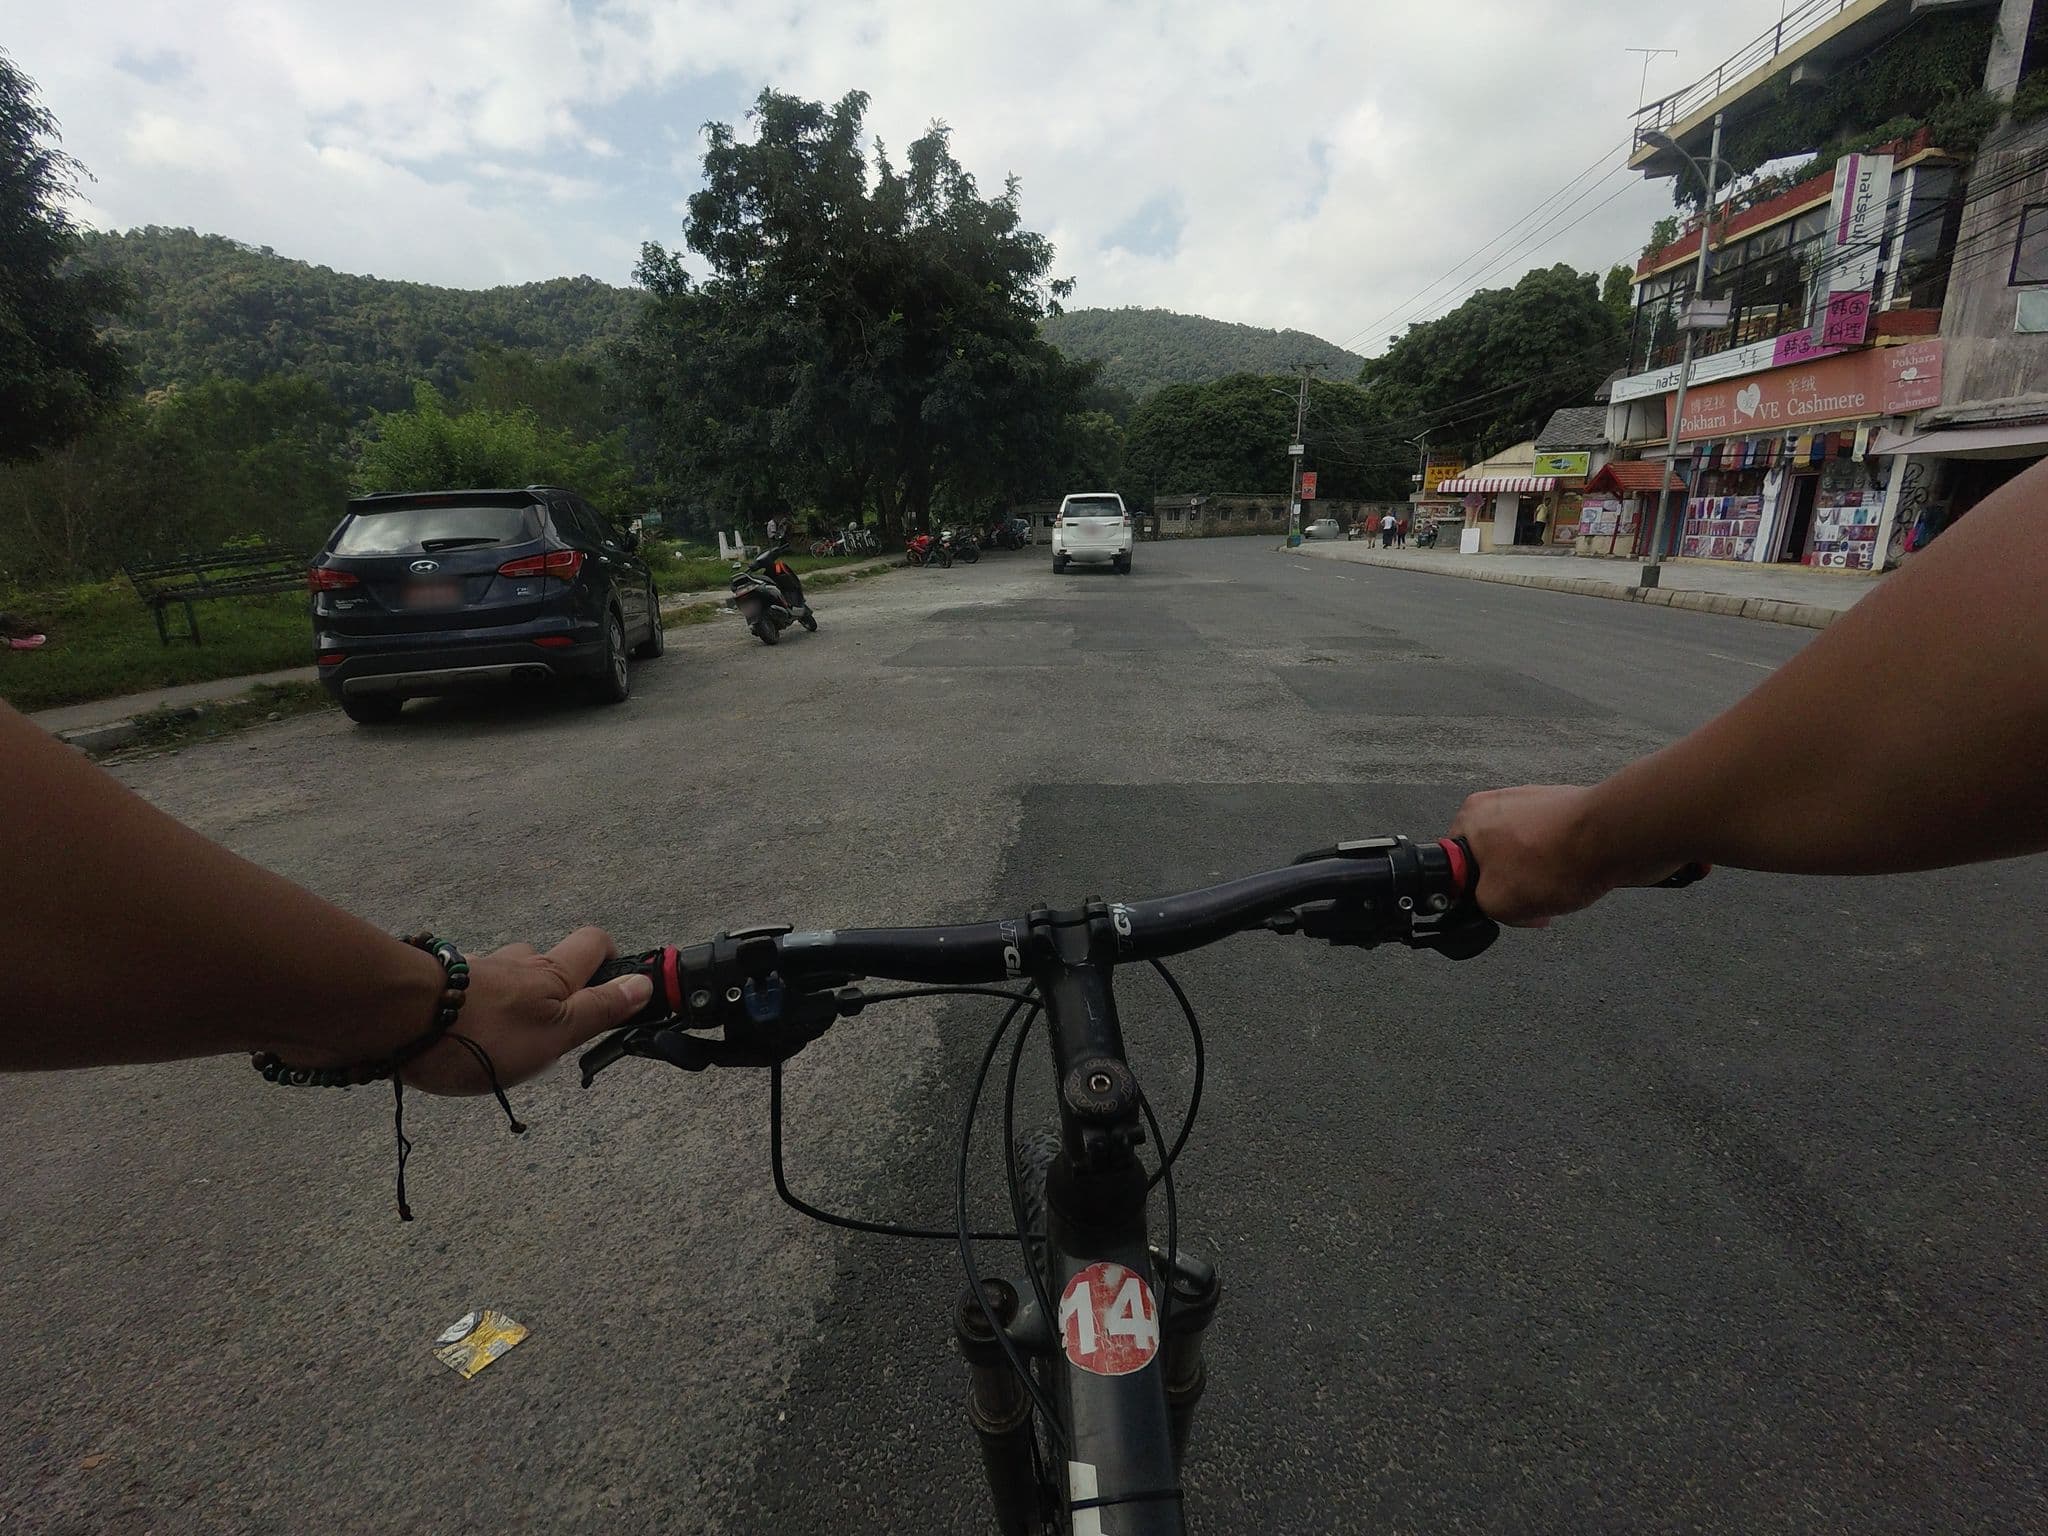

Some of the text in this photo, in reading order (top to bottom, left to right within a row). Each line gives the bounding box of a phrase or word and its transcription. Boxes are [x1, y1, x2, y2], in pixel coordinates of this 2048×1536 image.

[1892, 354, 1936, 368] Pokhara
[1680, 414, 1726, 433] Pokhara
[1787, 392, 1865, 416] Cashmere
[1059, 1278, 1154, 1355] 14
